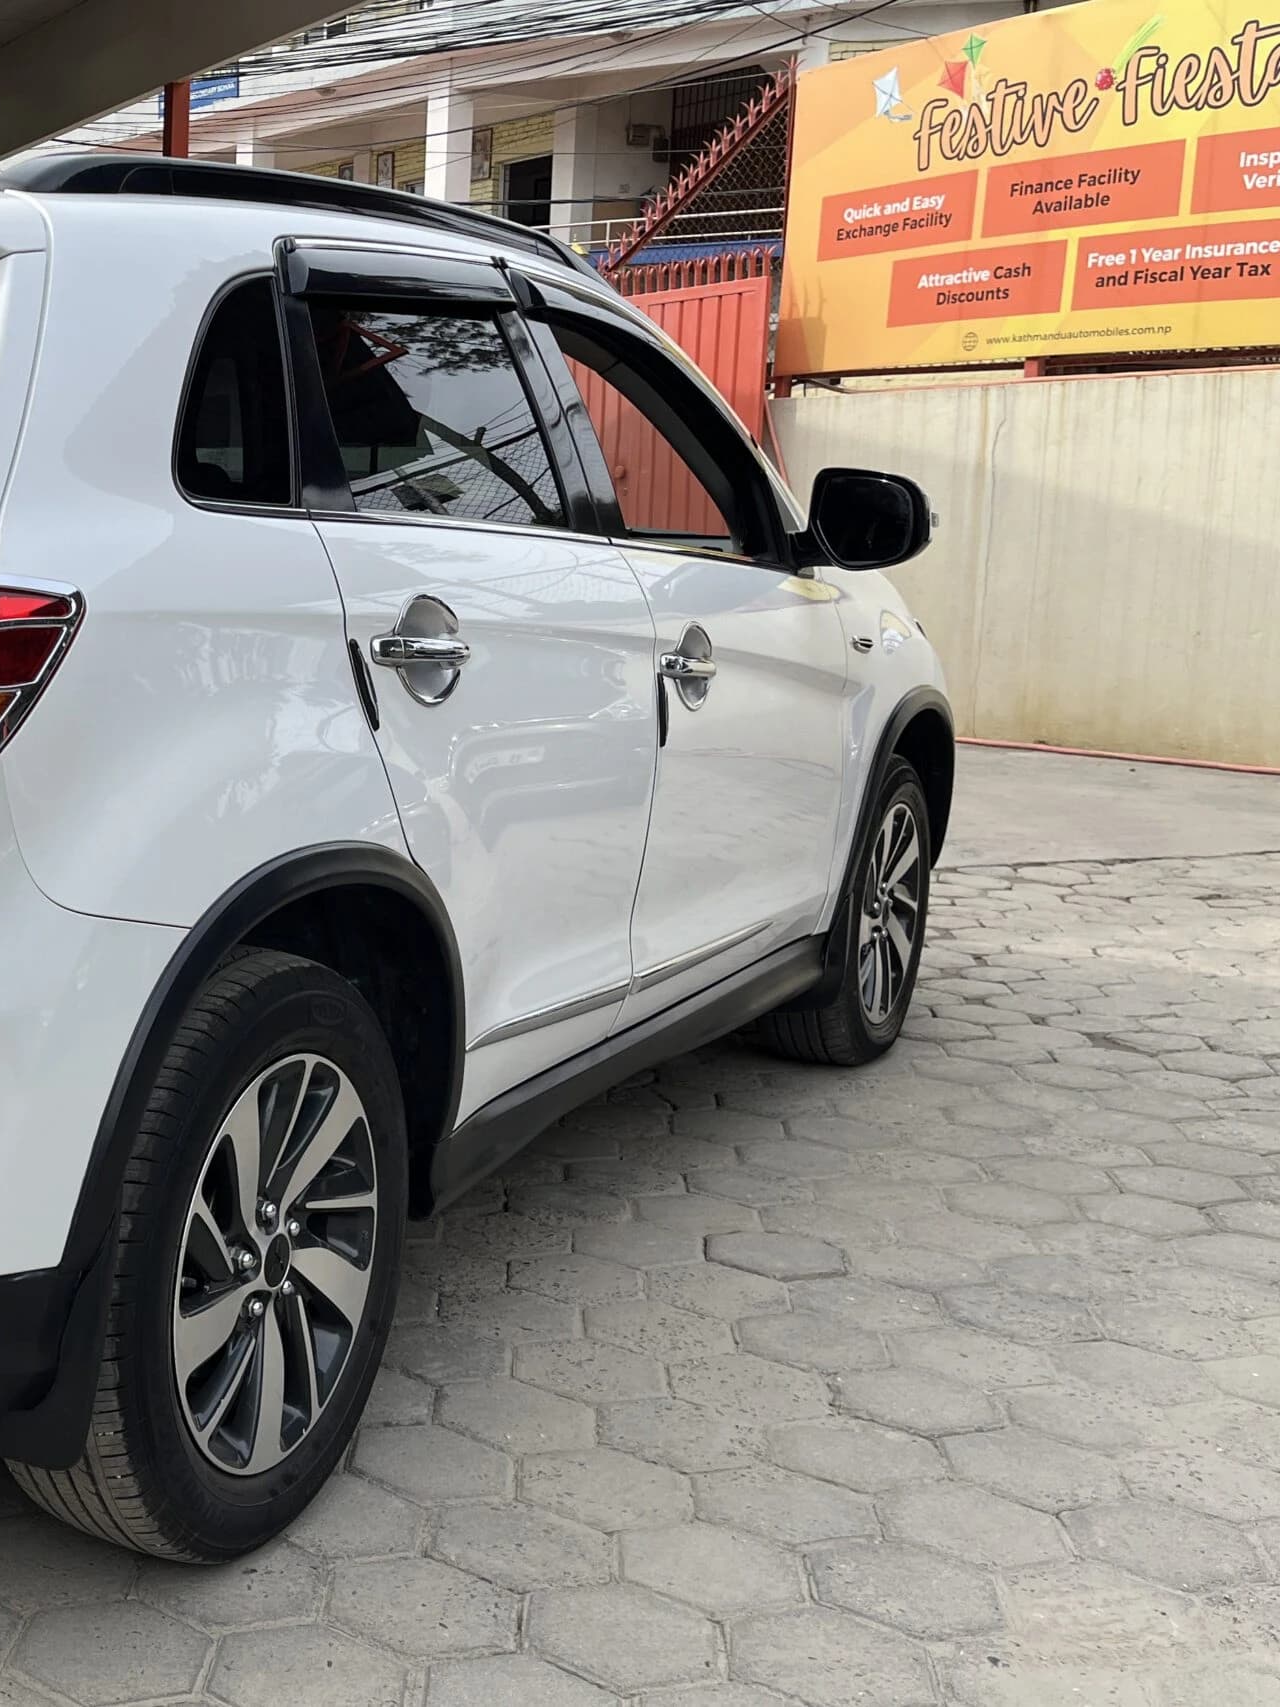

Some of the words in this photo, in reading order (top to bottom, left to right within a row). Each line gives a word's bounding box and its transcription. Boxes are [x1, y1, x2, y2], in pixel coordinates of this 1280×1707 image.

[1010, 178, 1073, 197] Finance
[1078, 167, 1141, 188] Facility
[843, 203, 881, 224] Quick
[883, 197, 910, 215] and
[912, 194, 945, 211] Easy
[1032, 192, 1110, 215] Available
[836, 221, 899, 241] Exchange
[902, 211, 952, 231] Facility
[1087, 251, 1126, 268] Free
[1130, 248, 1137, 264] 1
[1141, 247, 1181, 263] Year
[1185, 239, 1280, 260] Insurance
[917, 267, 991, 289] Attractive
[993, 262, 1032, 280] Cash
[1095, 271, 1129, 288] and
[1133, 266, 1185, 285] Fiscal
[1190, 265, 1232, 281] Year
[1236, 262, 1272, 277] Tax
[936, 286, 1010, 306] Discounts
[986, 325, 1172, 345] www.kathmanduautomobiles.com.np
